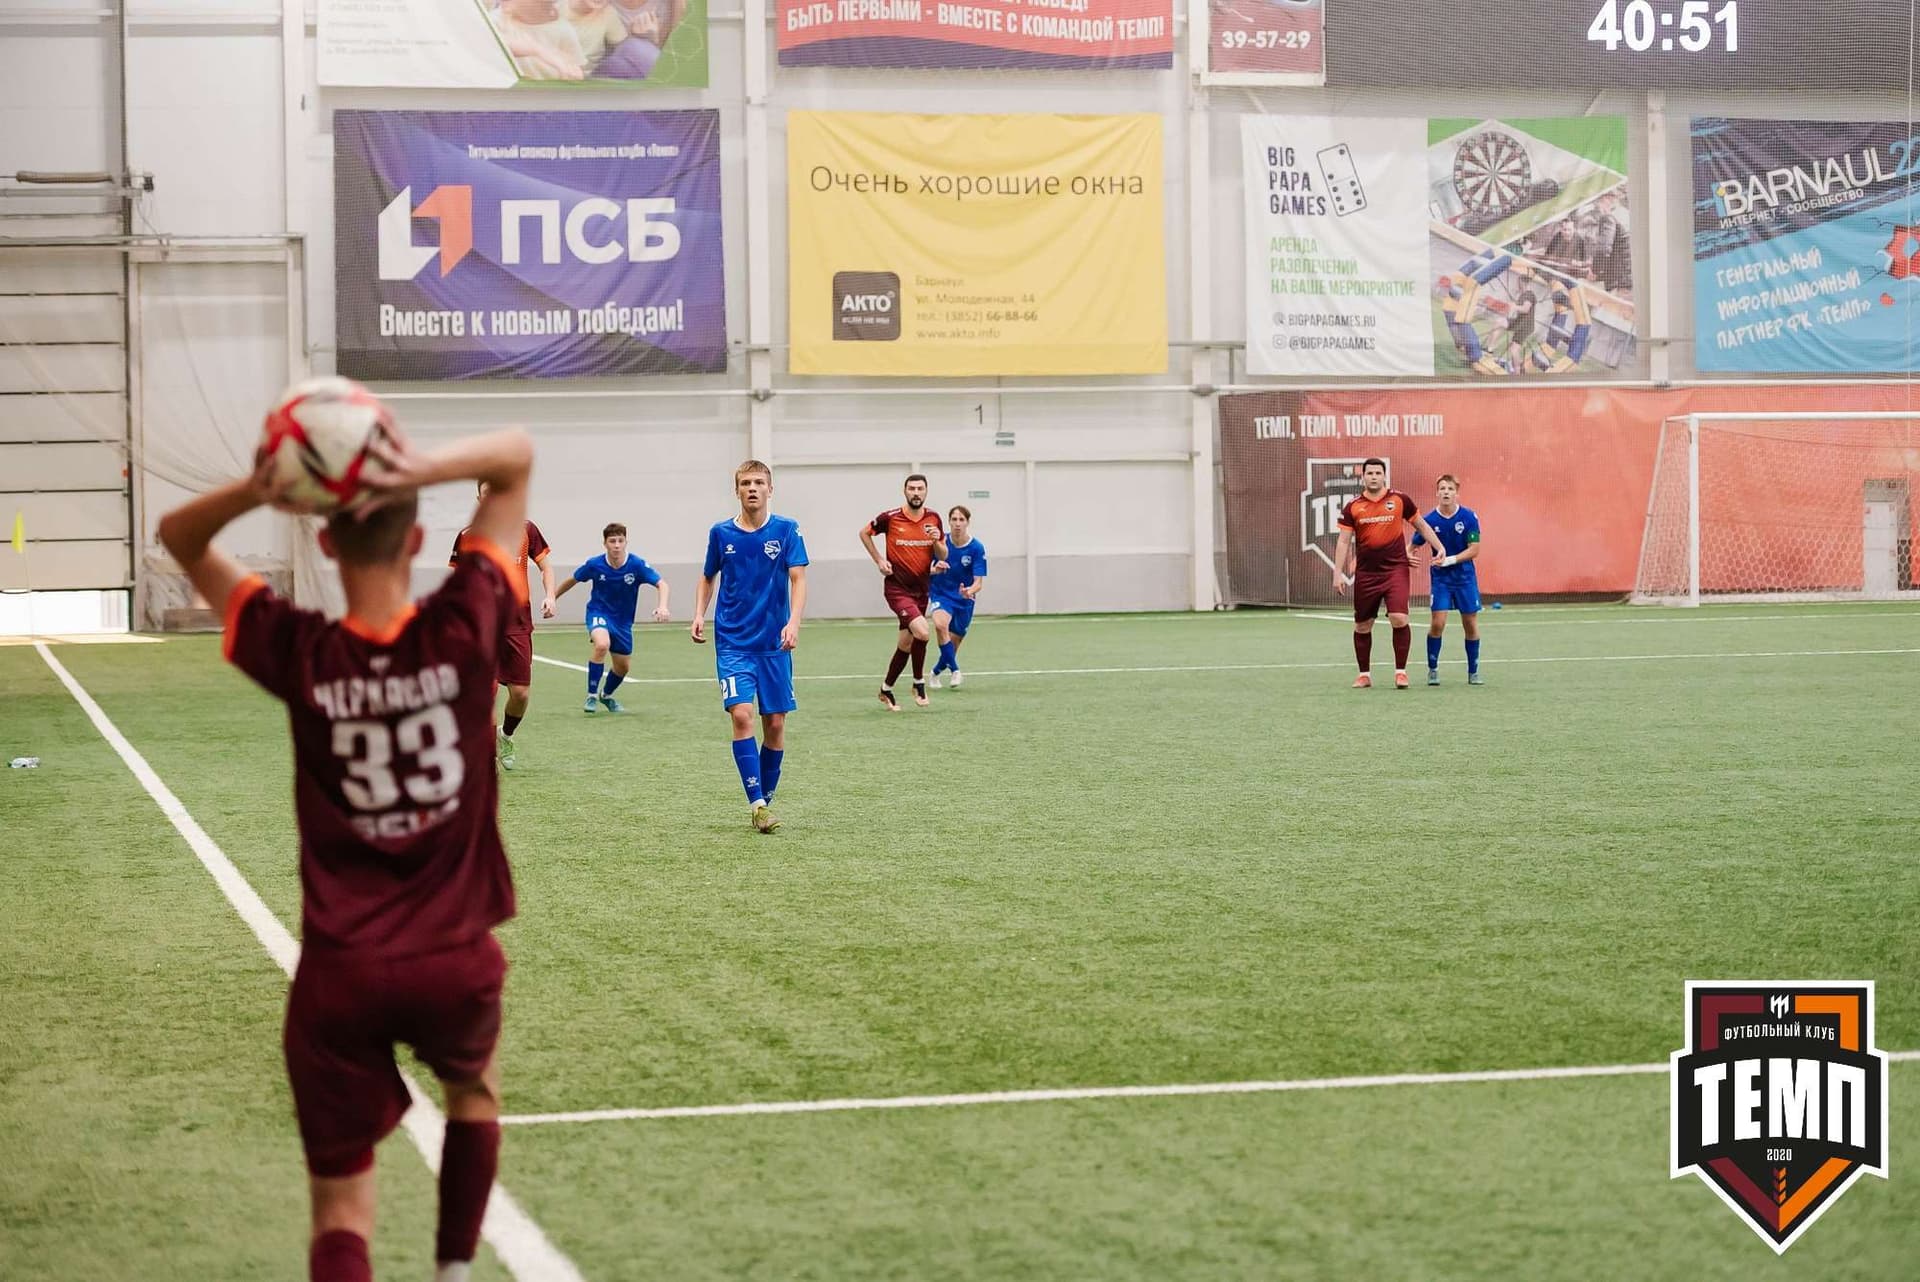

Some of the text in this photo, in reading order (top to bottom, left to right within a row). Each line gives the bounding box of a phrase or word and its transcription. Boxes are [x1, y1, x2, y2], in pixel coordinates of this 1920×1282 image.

[787, 3, 834, 32] БЫТЬ
[837, 0, 922, 22] ПЕРВЫМИ
[938, 3, 1003, 32] ВМЕСТЕ
[1006, 12, 1018, 33] С
[1022, 14, 1114, 43] КОМАНДОЙ
[1117, 16, 1165, 40] ТЕМП!
[1587, 0, 1738, 51] 40:51
[1222, 30, 1311, 48] 39-57-29
[1268, 146, 1295, 167] BIG
[810, 166, 1143, 201] Очень хорошие окна
[1269, 170, 1312, 191] PAPA
[1270, 194, 1326, 216] GAMES
[500, 197, 682, 264] ПСБ
[1270, 236, 1318, 254] АРЕНДА
[1715, 245, 1823, 289] ГЕНЕРАЛЬНЫЙ
[1271, 279, 1415, 296] НА ВАШЕ МЕРОПРИЯТИЕ
[1717, 266, 1862, 321] ИНФОРМАЦИОННЫЙ
[379, 298, 684, 337] Вместе к новым победам!
[986, 310, 1038, 321] 66-88-66
[1288, 313, 1376, 327] BIGPAPAGAMES.RU
[1716, 318, 1784, 349] ПАРТНЕР
[1786, 310, 1813, 333] ФК
[974, 404, 983, 425] 1
[1254, 414, 1444, 440] ТЕМП, ТЕМП, ТОЛЬКО ТЕМП!
[331, 703, 466, 811] 33
